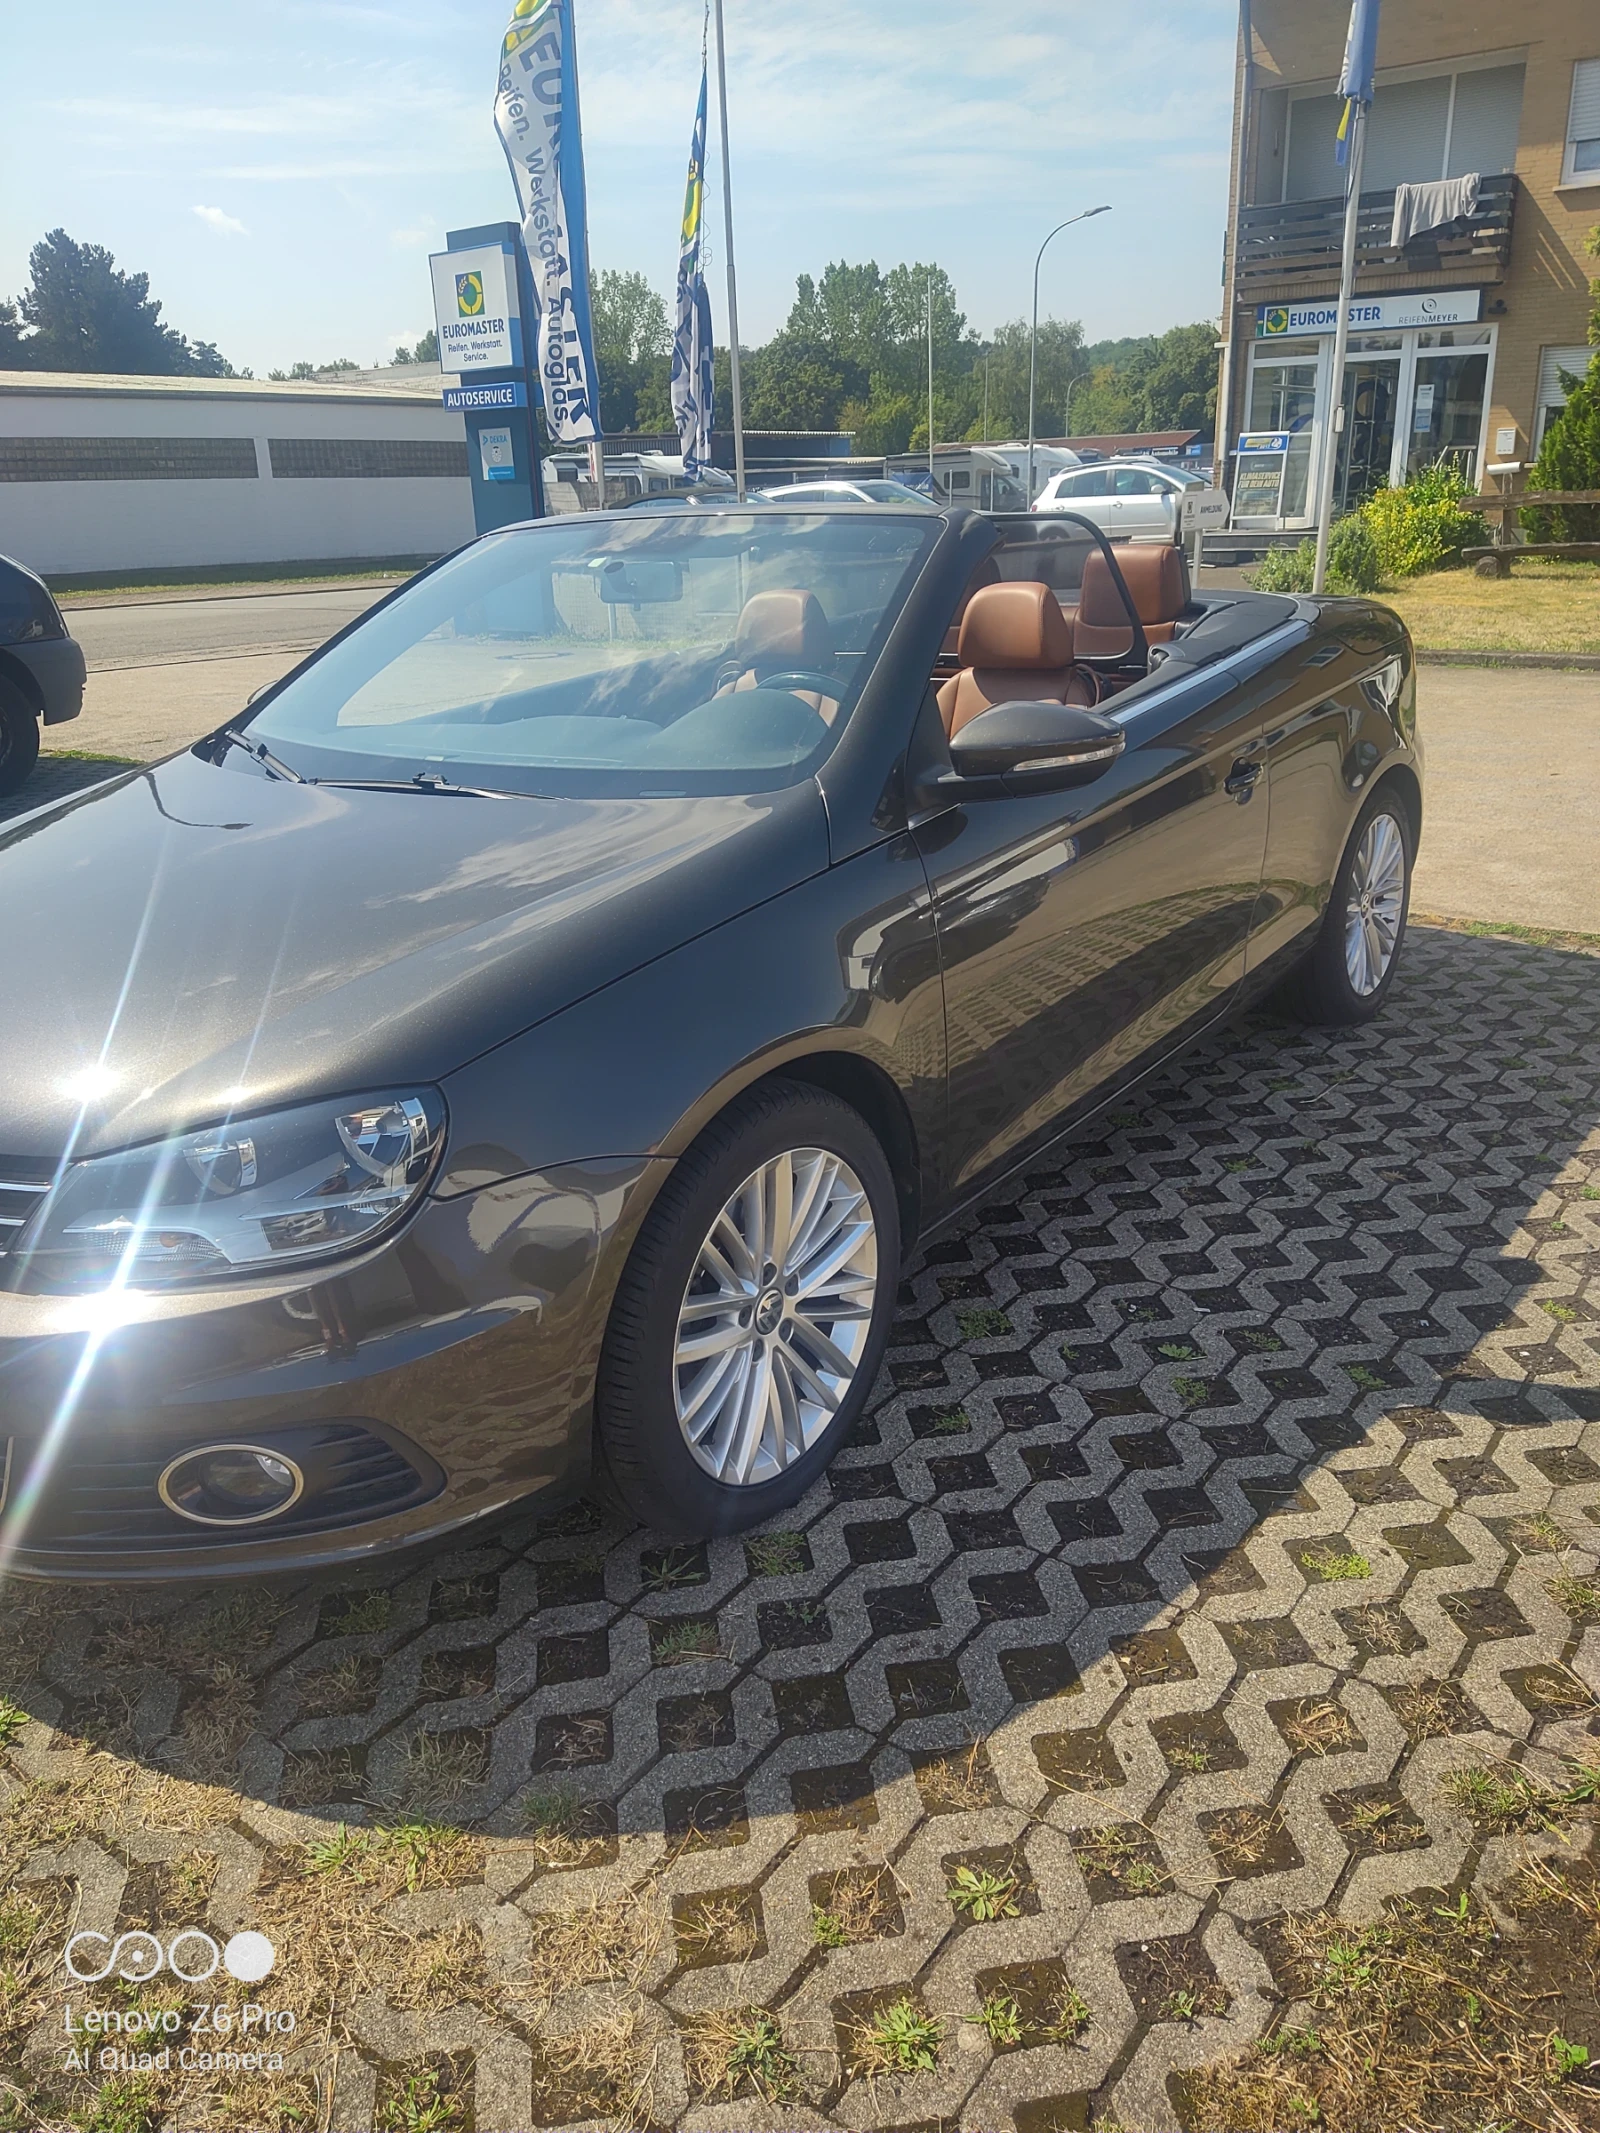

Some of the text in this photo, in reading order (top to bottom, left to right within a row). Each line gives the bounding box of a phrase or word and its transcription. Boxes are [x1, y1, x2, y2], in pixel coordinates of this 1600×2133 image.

[525, 147, 560, 286] Werkstatt.
[544, 297, 569, 429] Autoglas.
[1289, 305, 1381, 327] EUROMSTER
[1398, 313, 1458, 324] REIFENMEYER
[442, 318, 505, 339] EUROMASTER
[448, 339, 503, 353] Reifen. Werkstatt.
[463, 352, 489, 362] Service.
[447, 388, 513, 407] AUTOSERVICE
